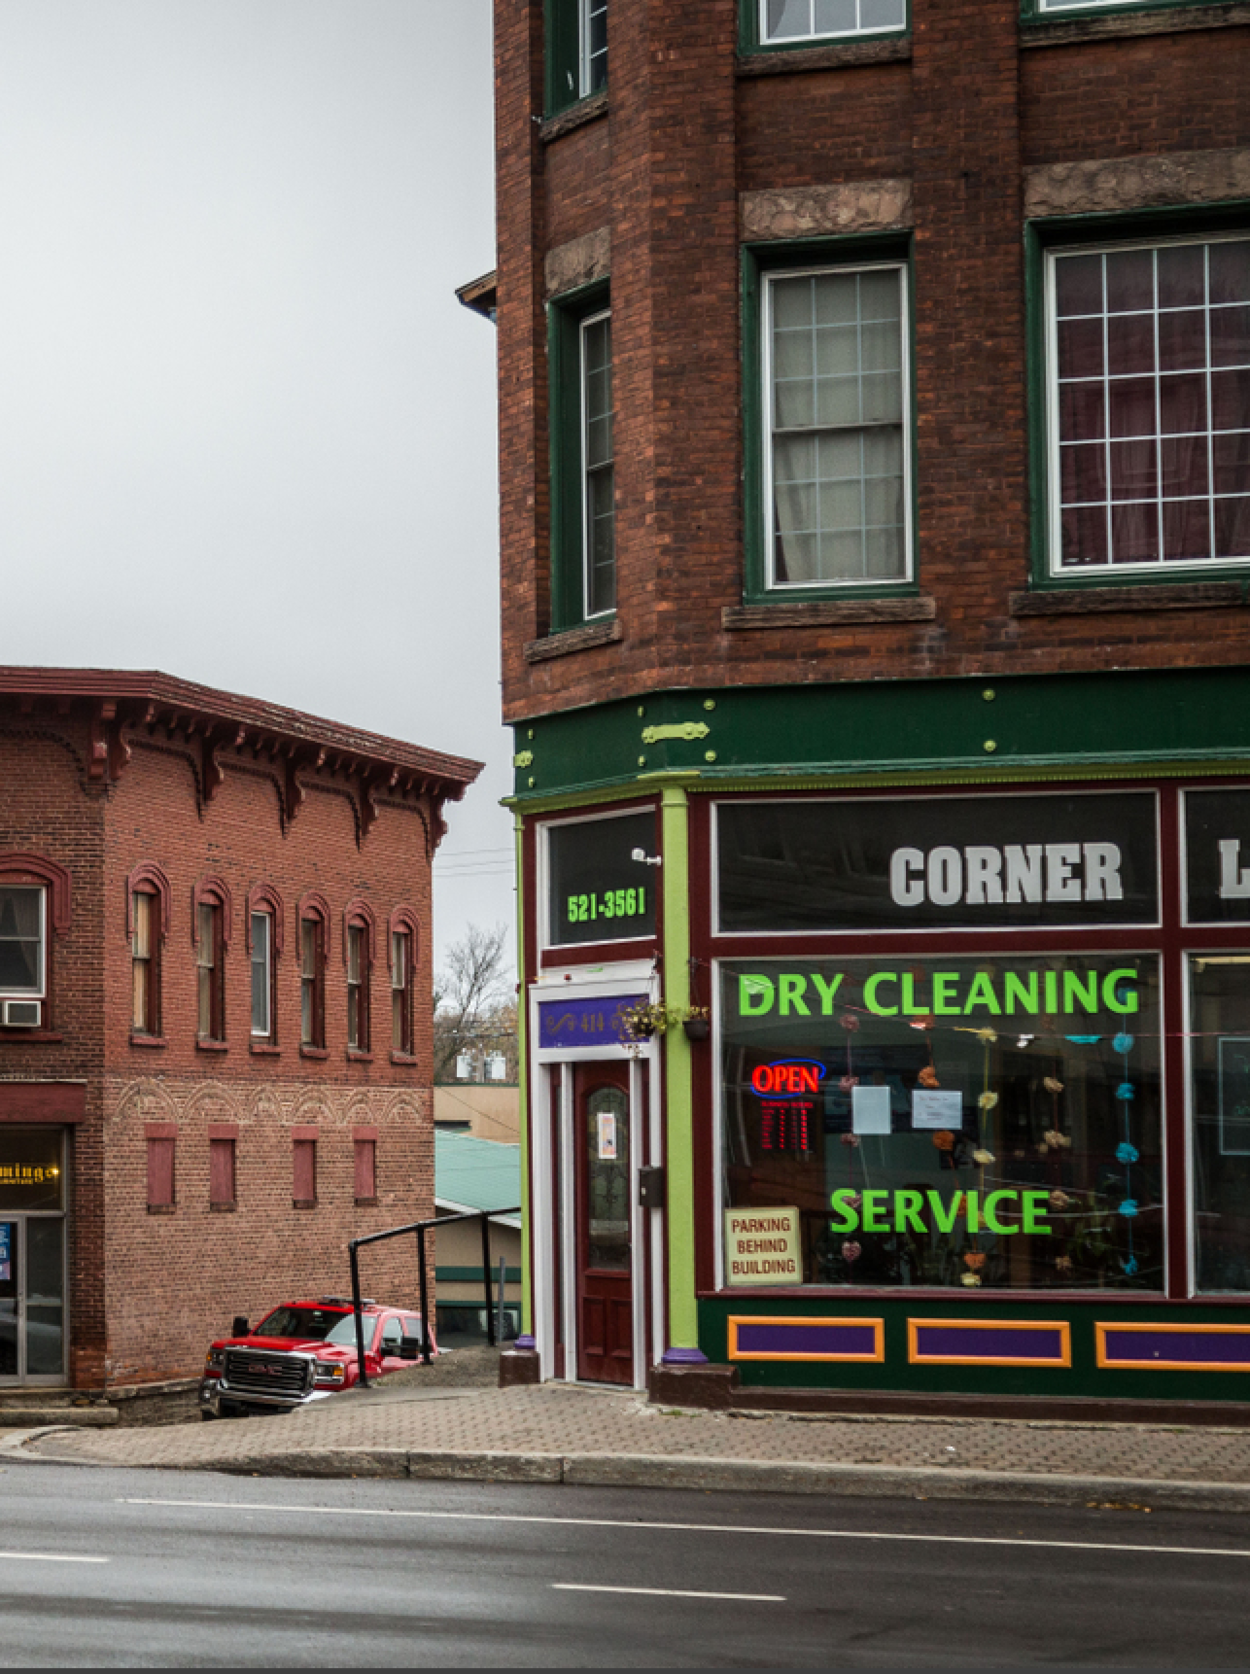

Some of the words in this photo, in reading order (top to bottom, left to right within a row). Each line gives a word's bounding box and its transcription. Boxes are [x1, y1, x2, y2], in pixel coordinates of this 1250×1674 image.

[890, 842, 1123, 906] CORNER
[567, 886, 646, 923] 521-3561
[738, 973, 844, 1016] DRY
[863, 969, 1139, 1016] CLEANING
[752, 1065, 819, 1093] OPEN
[731, 1217, 791, 1233] PARKING
[830, 1188, 1052, 1235] SERVICE
[736, 1238, 788, 1254] BEHIND
[731, 1258, 796, 1275] BUILDING
